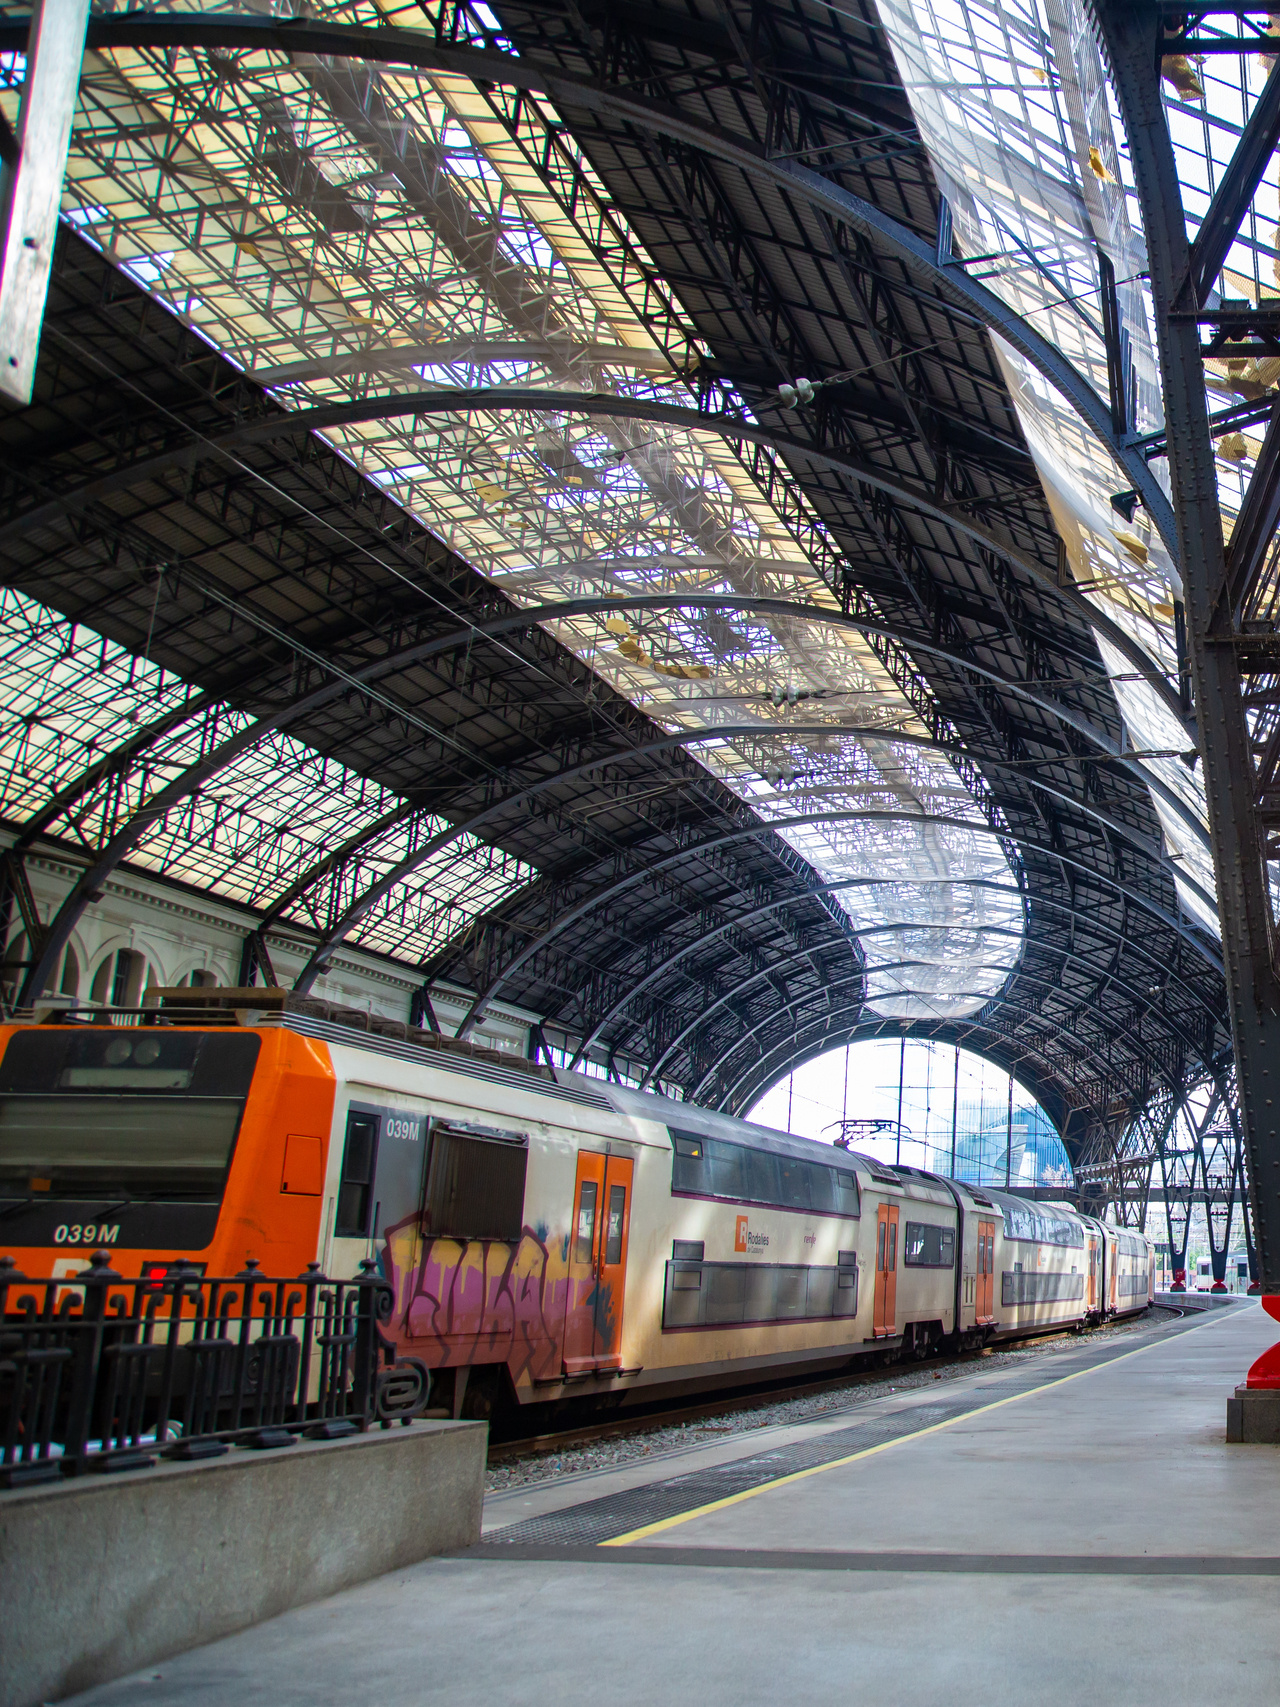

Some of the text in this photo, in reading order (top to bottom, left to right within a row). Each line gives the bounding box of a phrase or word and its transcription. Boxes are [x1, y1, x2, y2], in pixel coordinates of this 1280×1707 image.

[386, 1118, 420, 1141] 039M
[54, 1224, 120, 1243] 039M
[747, 1231, 770, 1246] Rodalies
[803, 1232, 817, 1249] renfe
